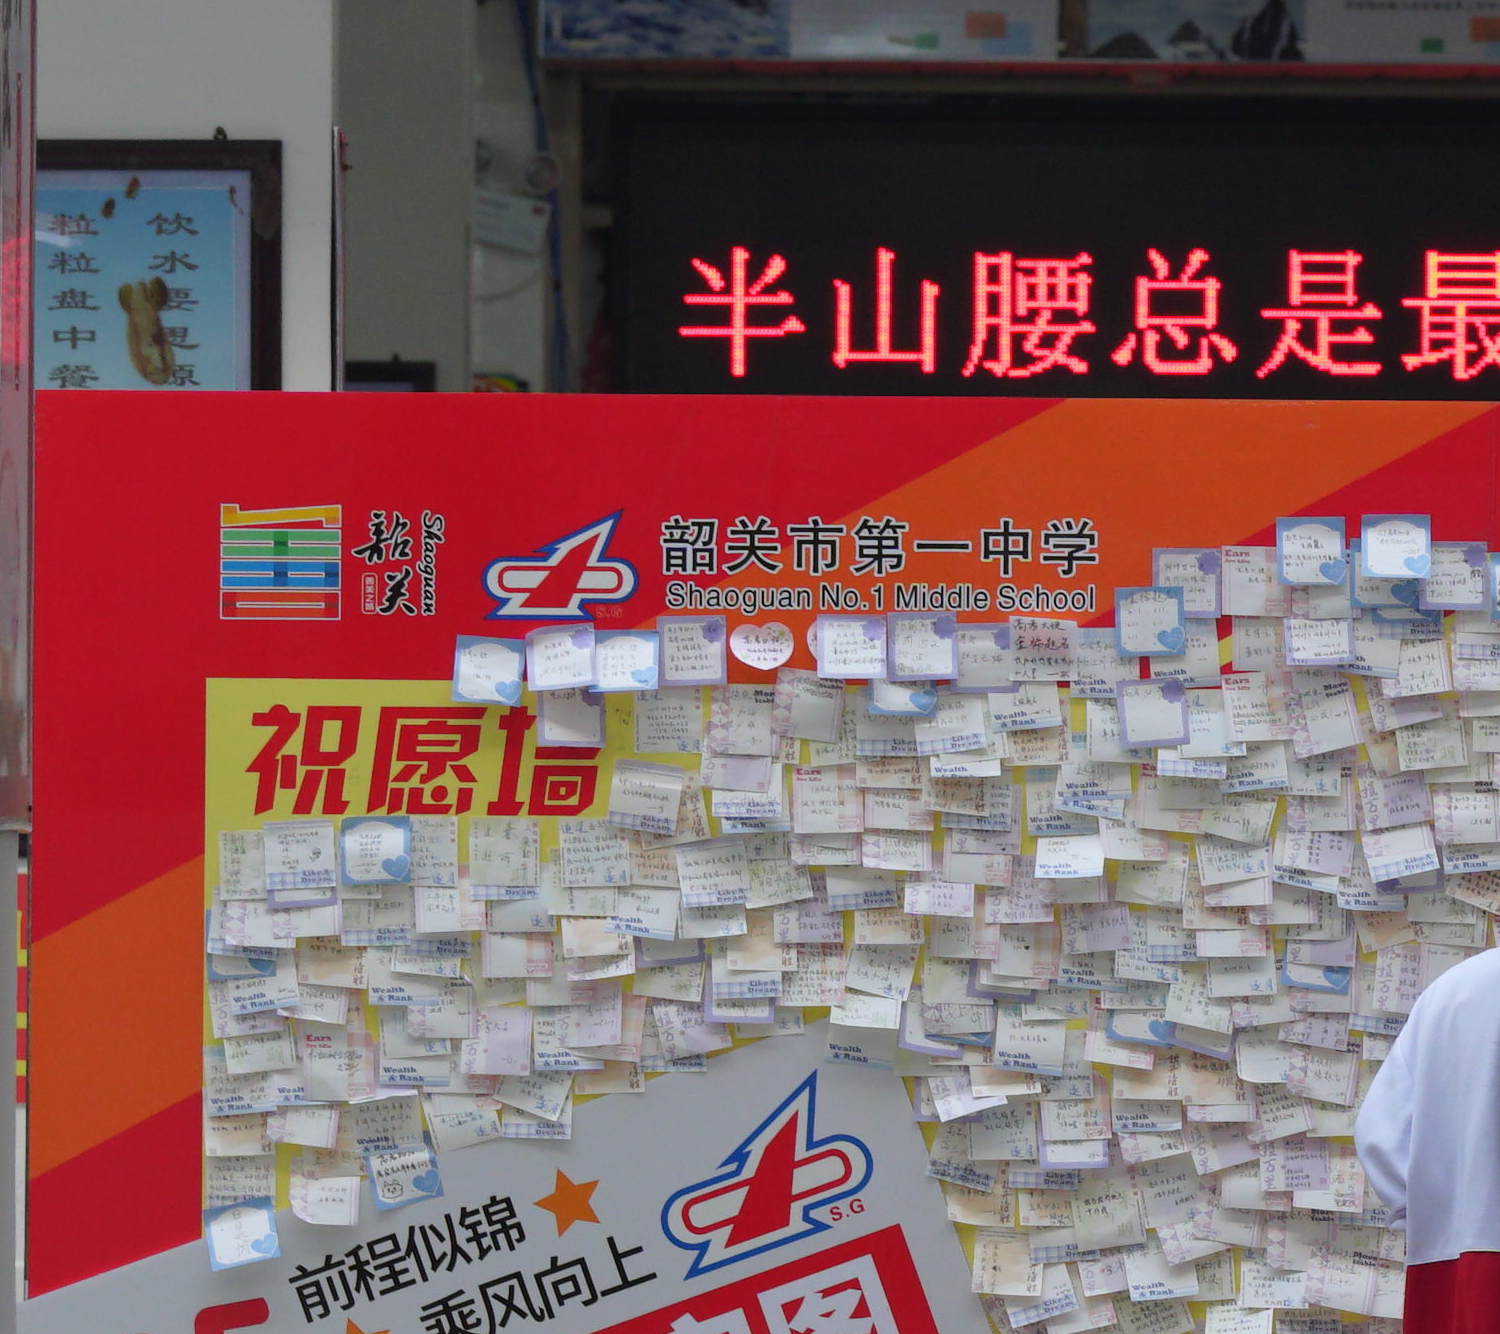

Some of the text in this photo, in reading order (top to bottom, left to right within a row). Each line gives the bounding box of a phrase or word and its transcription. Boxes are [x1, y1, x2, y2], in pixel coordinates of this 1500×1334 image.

[420, 510, 446, 617] Shaoguan
[661, 516, 1098, 577] 韶关市第一中学
[667, 583, 1095, 613] Shaoguan No.1 Middle School
[246, 704, 602, 816] 祝愿墙
[829, 1198, 865, 1221] S.G
[288, 1194, 527, 1325] 前程似锦
